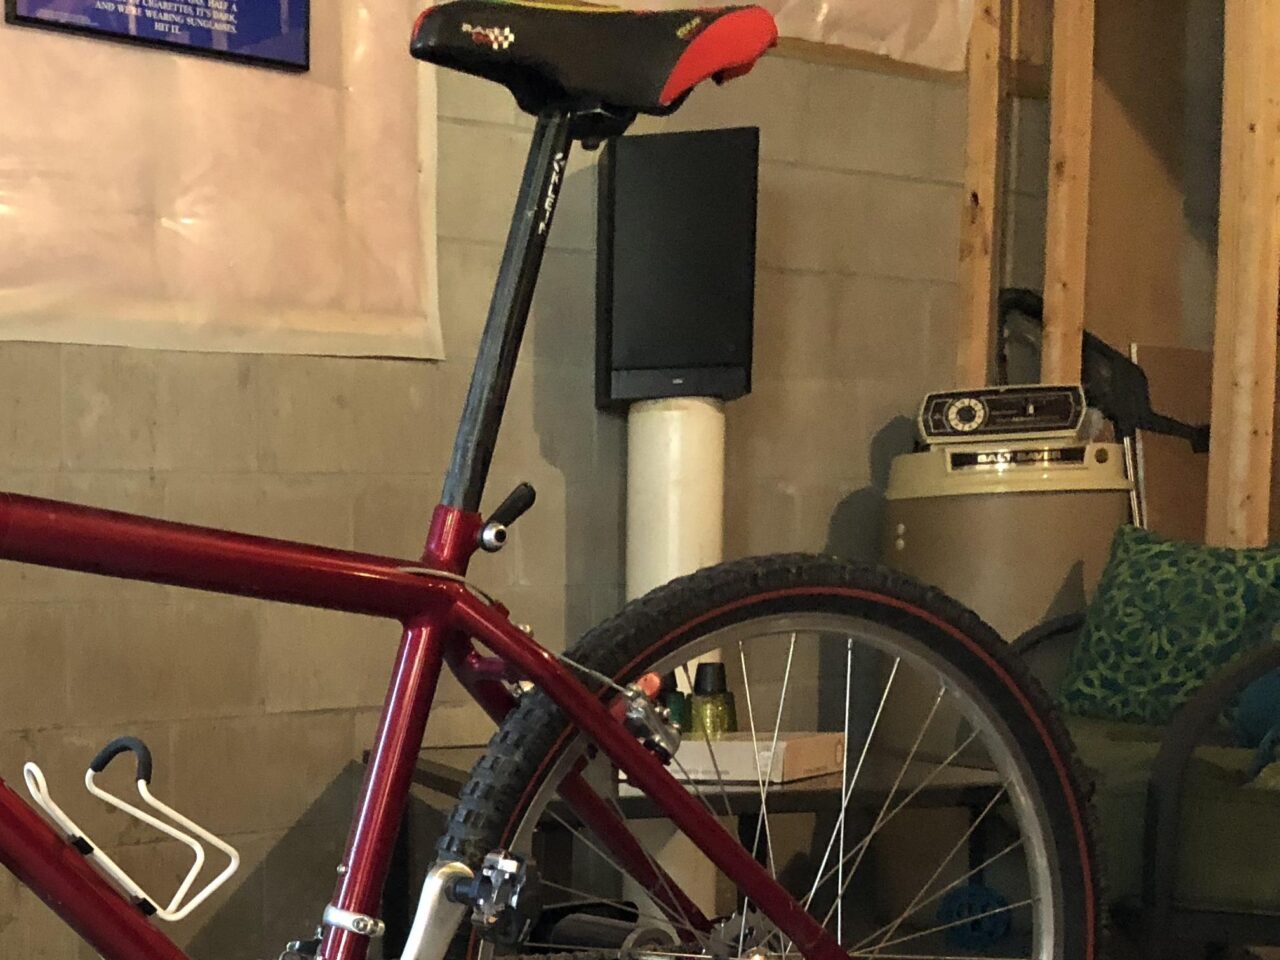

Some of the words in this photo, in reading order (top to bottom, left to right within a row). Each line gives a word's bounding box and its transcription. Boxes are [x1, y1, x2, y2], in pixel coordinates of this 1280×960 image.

[95, 1, 116, 12] AND
[145, 9, 185, 24] WEARING
[154, 22, 169, 32] HIT
